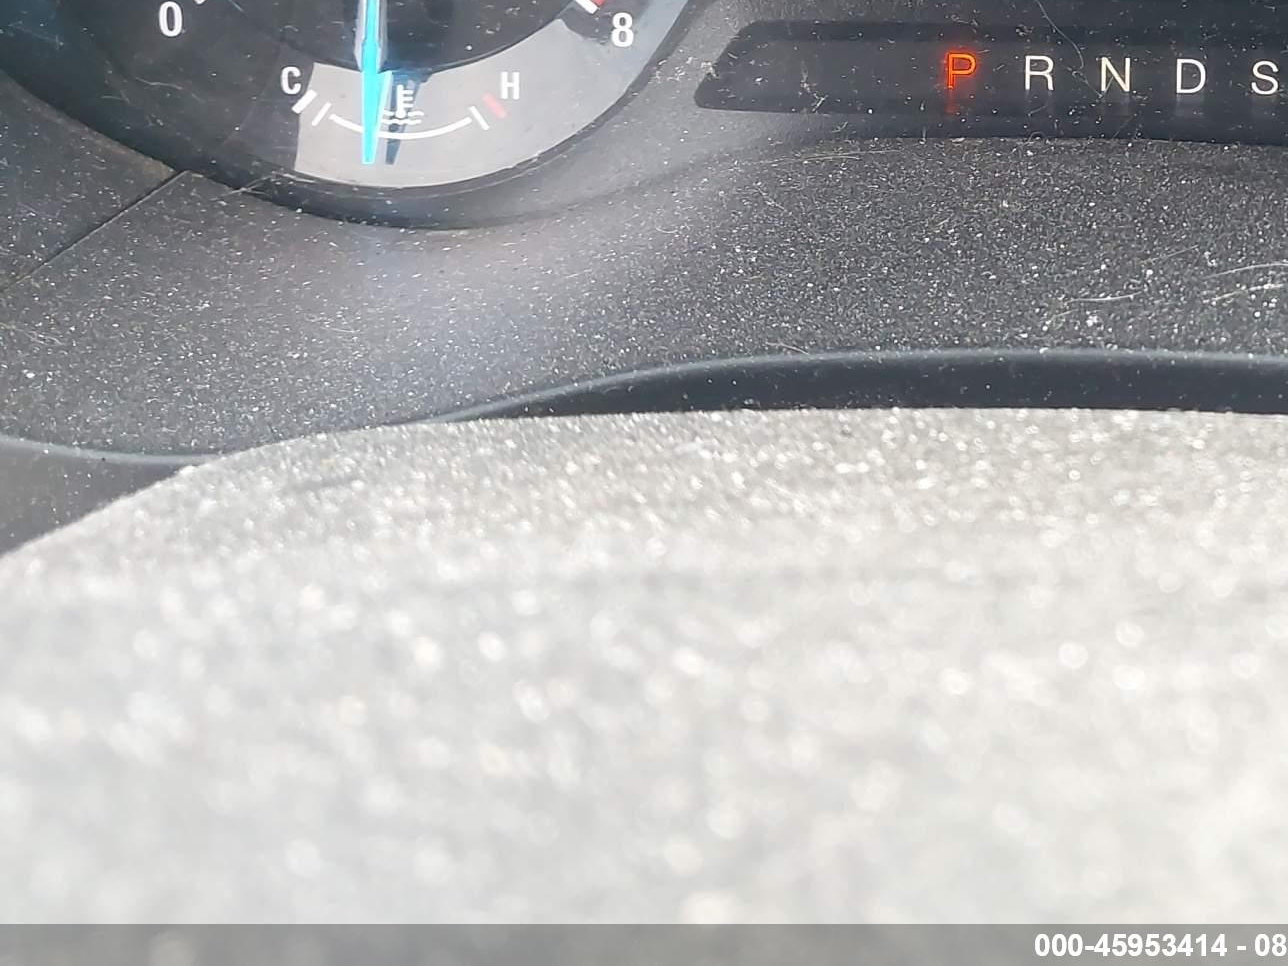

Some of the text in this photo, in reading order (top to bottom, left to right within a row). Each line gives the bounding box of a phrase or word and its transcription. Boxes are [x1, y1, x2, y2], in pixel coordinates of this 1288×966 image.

[159, 2, 182, 36] 0
[610, 12, 636, 48] 8
[281, 66, 303, 96] C
[501, 72, 519, 101] H
[945, 53, 1278, 94] P R N D S
